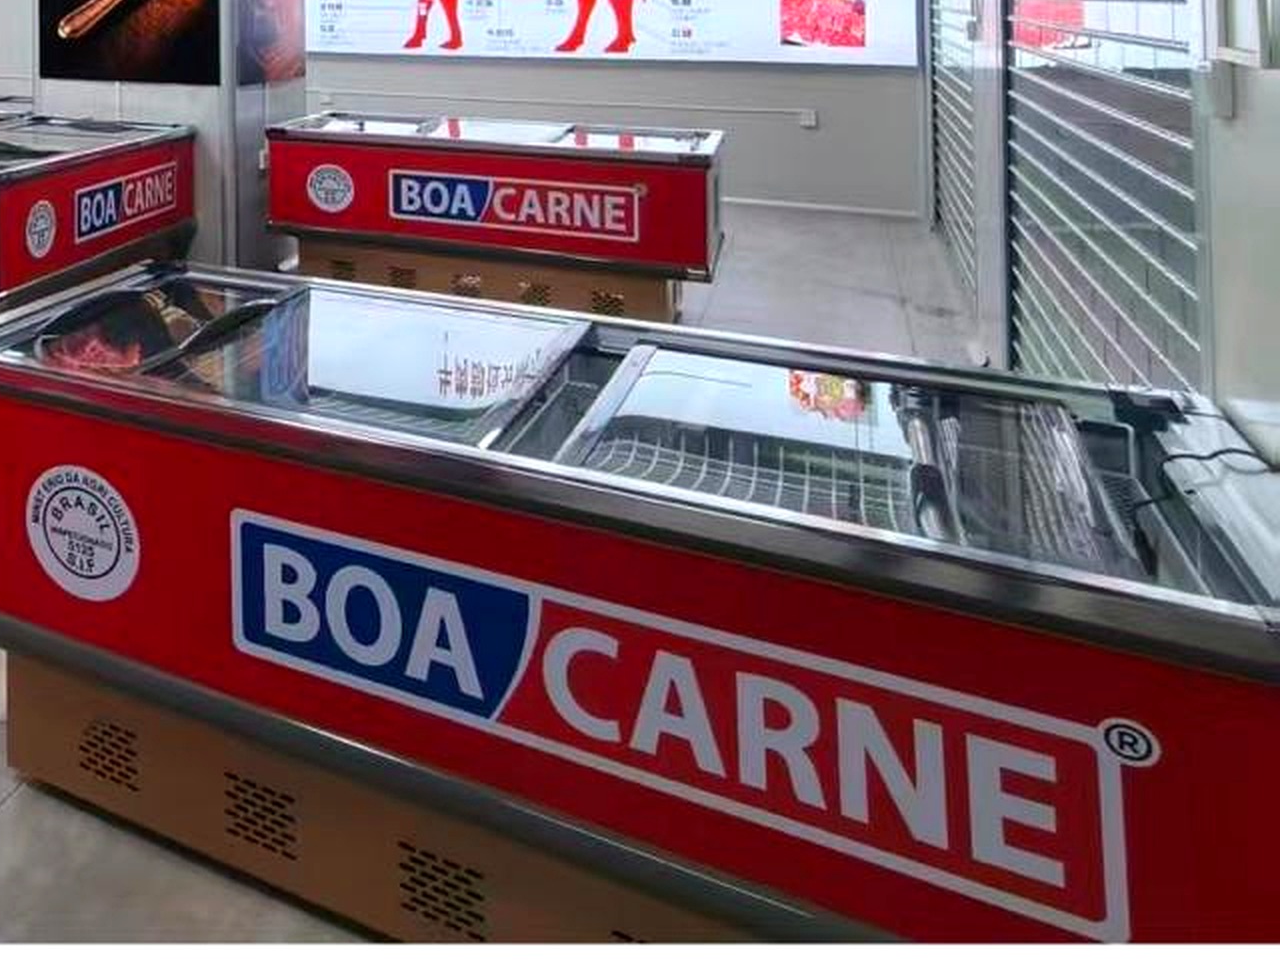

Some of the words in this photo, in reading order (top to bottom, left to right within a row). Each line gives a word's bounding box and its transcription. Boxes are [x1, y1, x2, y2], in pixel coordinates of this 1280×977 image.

[80, 189, 117, 233] BOA
[124, 171, 173, 216] CARNE
[401, 177, 476, 217] BOA
[493, 187, 627, 231] CARNE
[51, 495, 110, 534] BRASIL
[263, 542, 483, 701] BOA
[542, 627, 1066, 889] CARNE
